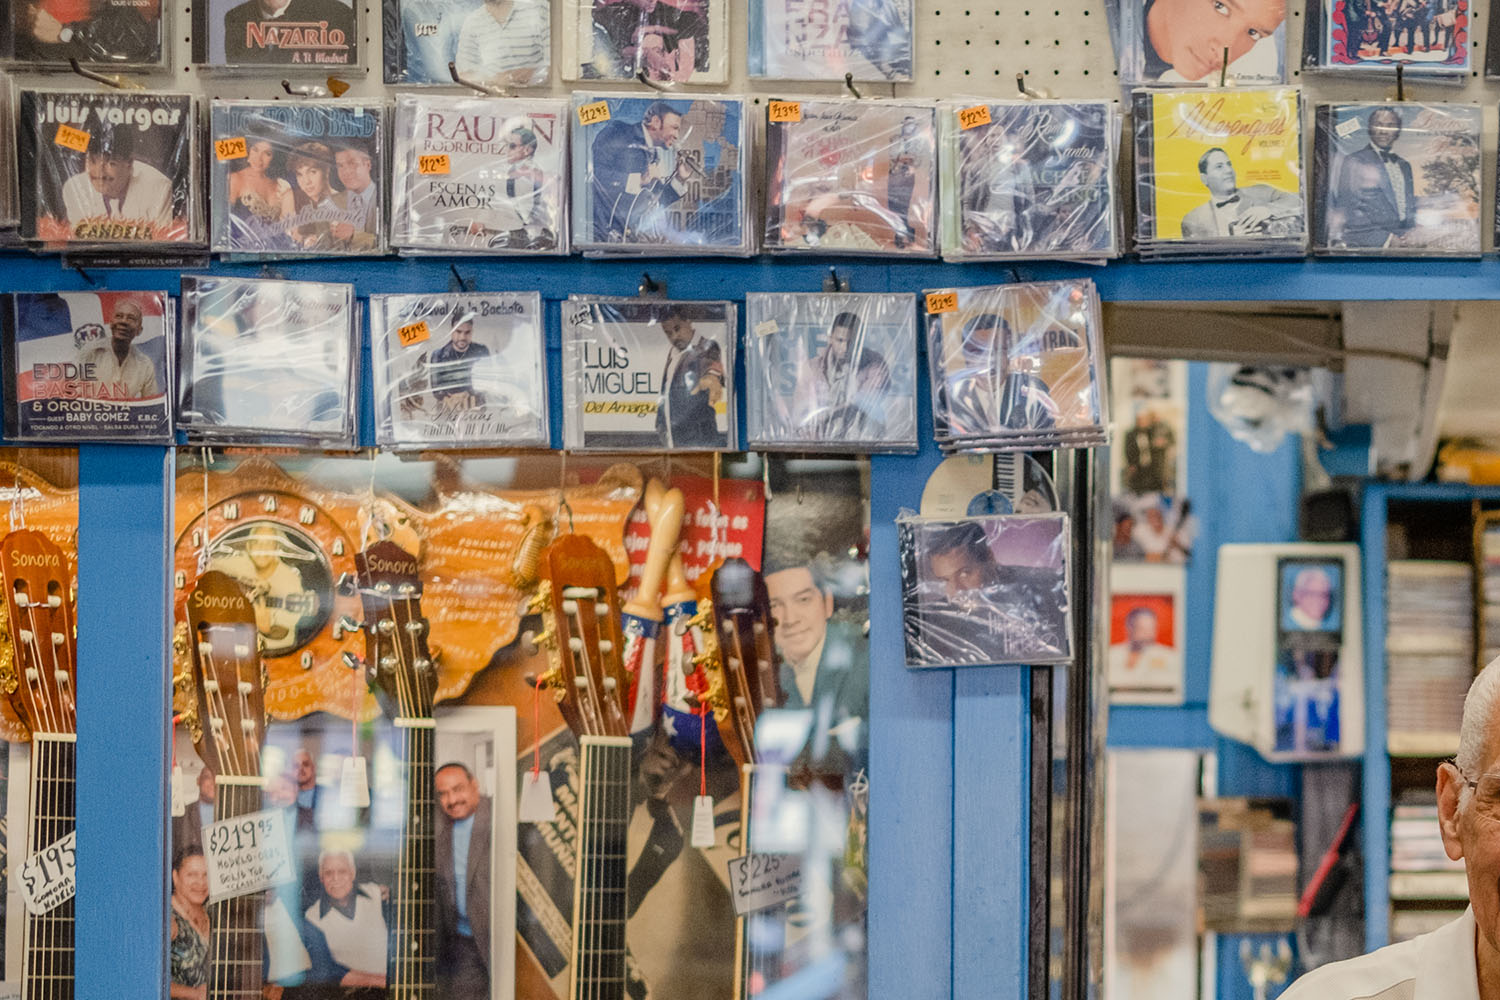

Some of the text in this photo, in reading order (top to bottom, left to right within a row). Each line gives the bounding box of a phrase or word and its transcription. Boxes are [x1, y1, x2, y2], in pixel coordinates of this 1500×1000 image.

[246, 21, 349, 49] NAZARIO
[47, 101, 182, 131] luis vargas
[578, 104, 609, 123] $1295
[330, 110, 376, 137] BAND
[1167, 97, 1288, 156] Merengues
[419, 157, 447, 174] $1295
[430, 180, 496, 197] ESCENAS
[433, 193, 493, 211] AMOR
[584, 343, 630, 370] LUIS
[32, 362, 97, 381] EDDIE
[33, 381, 129, 399] BASTIAN
[584, 371, 659, 395] MIGUEL
[47, 400, 131, 412] ORQUESTA
[584, 400, 606, 414] Del
[66, 412, 93, 422] BABY
[94, 412, 130, 422] GOMEZ
[10, 549, 61, 568] Sonora
[368, 553, 418, 575] Sonora
[194, 589, 245, 611] Sonora
